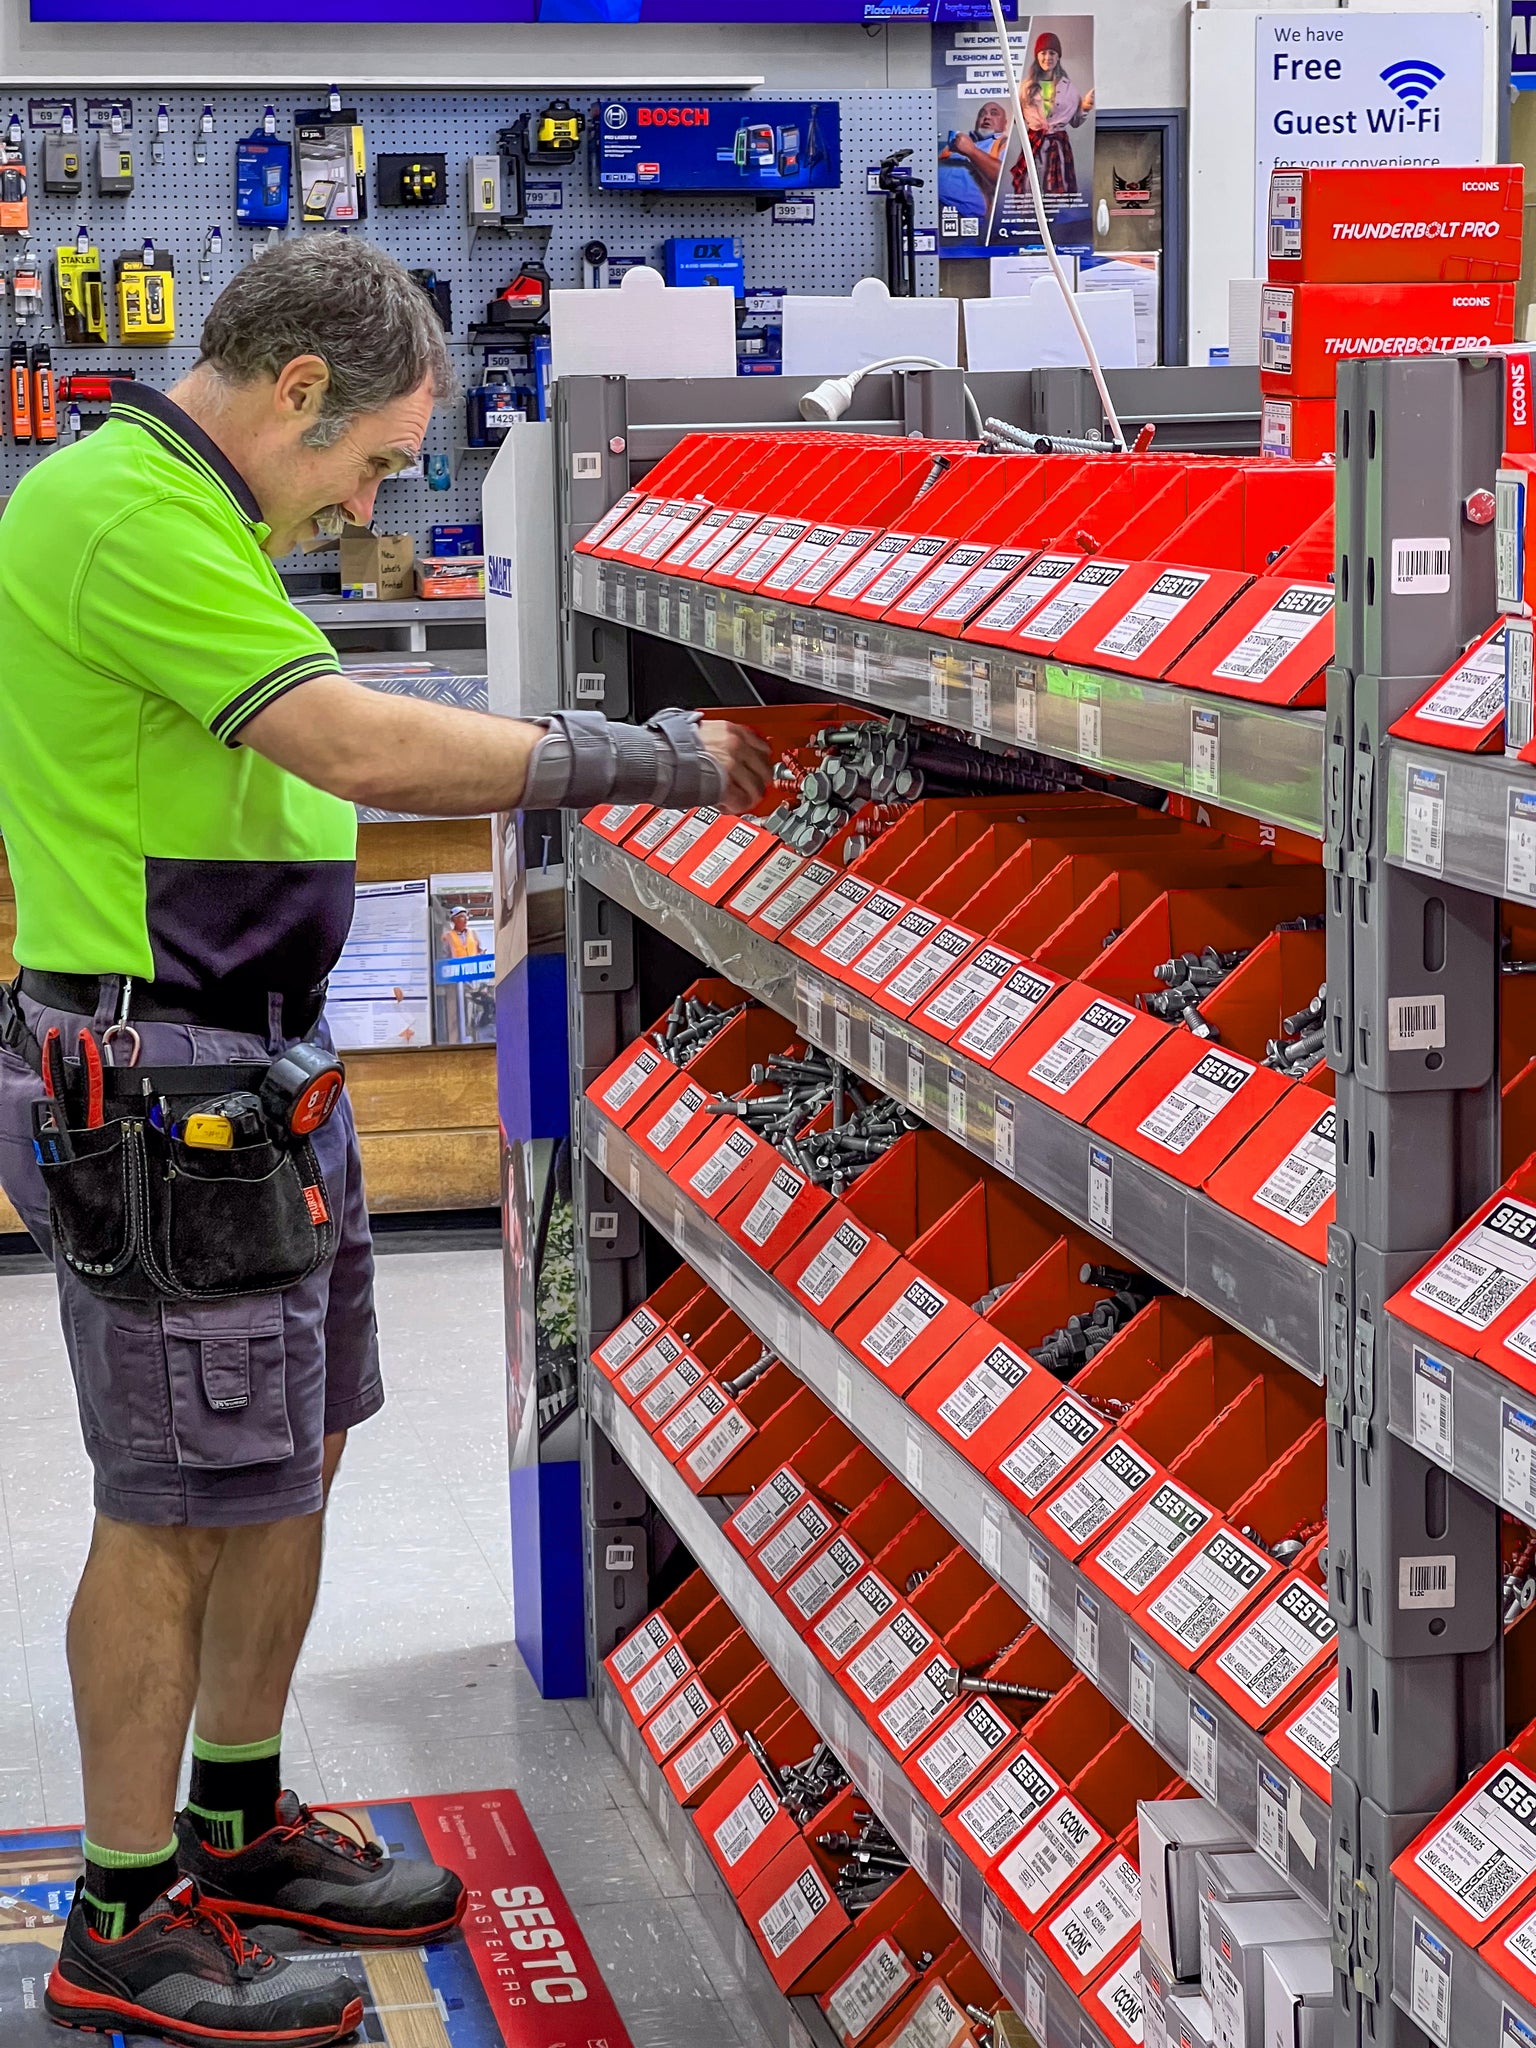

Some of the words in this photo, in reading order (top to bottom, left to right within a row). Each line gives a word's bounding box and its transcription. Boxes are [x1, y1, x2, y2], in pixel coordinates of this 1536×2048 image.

[864, 4, 929, 15] PlaceMakers
[1274, 28, 1301, 42] We
[1306, 27, 1344, 42] have
[1273, 54, 1341, 80] Free
[40, 112, 53, 120] 69
[97, 112, 110, 120] 89
[638, 108, 709, 126] BOSCH
[1273, 110, 1357, 135] Guest
[1366, 107, 1440, 133] Wi-Fi
[1274, 157, 1296, 167] for
[1342, 156, 1440, 167] convenience
[526, 193, 544, 201] 799
[1462, 182, 1499, 191] ICCONS
[779, 206, 796, 215] 399
[944, 222, 955, 230] H1
[1333, 222, 1460, 239] THUNDERBOLT
[1463, 221, 1500, 238] PRO
[61, 256, 96, 264] STANLEY
[693, 244, 724, 259] OX
[753, 299, 765, 308] 97
[1453, 297, 1490, 307] ICCONS
[1325, 337, 1451, 354] THUNDERBOLT
[1453, 336, 1491, 351] PRO
[492, 357, 510, 366] 509
[1512, 364, 1527, 425] ICCONS
[491, 414, 514, 423] 1429
[777, 524, 801, 538] SESTO
[809, 531, 837, 545] SESTO
[841, 532, 869, 544] SESTO
[381, 551, 395, 559] New
[878, 538, 907, 551] SESTO
[911, 539, 943, 553] SESTO
[949, 550, 980, 565] SESTO
[986, 555, 1018, 569] SESTO
[1033, 562, 1069, 577] SESTO
[1078, 567, 1120, 584] SESTO
[381, 580, 403, 590] Printed
[1155, 576, 1199, 597] SESTO
[1279, 592, 1333, 613] SESTO
[697, 807, 718, 824] SESTO
[730, 828, 752, 846] SESTO
[805, 865, 831, 884] SESTO
[838, 880, 867, 900] SESTO
[868, 897, 897, 918] SESTO
[902, 912, 932, 935] SESTO
[935, 930, 967, 955] SESTO
[976, 951, 1010, 975] SESTO
[1010, 976, 1045, 1001] SESTO
[1085, 1006, 1125, 1033] SESTO
[1198, 1058, 1242, 1088] SESTO
[308, 1090, 320, 1109] 8
[682, 1090, 701, 1110] SESTO
[729, 1134, 751, 1155] SESTO
[775, 1169, 799, 1196] SESTO
[1288, 1171, 1322, 1212] ICCONS
[836, 1226, 863, 1254] SESTO
[907, 1285, 942, 1314] SESTO
[1460, 1271, 1498, 1313] ICCONS
[635, 1312, 654, 1333] SESTO
[658, 1338, 678, 1360] SESTO
[678, 1361, 697, 1383] SESTO
[989, 1350, 1024, 1383] SESTO
[700, 1388, 722, 1412] SESTO
[1055, 1406, 1093, 1441] SESTO
[1104, 1448, 1145, 1487] SESTO
[773, 1473, 798, 1502] SESTO
[1155, 1489, 1202, 1531] SESTO
[800, 1507, 825, 1538] SESTO
[831, 1542, 857, 1574] SESTO
[1208, 1538, 1260, 1584] SESTO
[860, 1578, 890, 1612] SESTO
[1177, 1597, 1212, 1635] ICCONS
[1285, 1590, 1336, 1637] SESTO
[647, 1619, 665, 1645] SESTO
[893, 1616, 926, 1652] SESTO
[666, 1647, 684, 1675] SESTO
[1248, 1649, 1284, 1688] ICCONS
[684, 1684, 706, 1715] SESTO
[968, 1704, 1003, 1745] SESTO
[1294, 1723, 1308, 1739] SKU:
[712, 1721, 731, 1751] SESTO
[1013, 1758, 1048, 1800] SESTO
[751, 1786, 773, 1821] SESTO
[1058, 1808, 1088, 1844] ICCONS
[1453, 1820, 1485, 1852] NNR05025
[1424, 1850, 1441, 1869] SKU:
[1461, 1852, 1500, 1896] ICCONS
[800, 1873, 824, 1909] SESTO
[467, 1890, 526, 2007] FASTENERS
[491, 1886, 588, 2004] SESTO
[1062, 1919, 1092, 1956] ICCONS
[1516, 1933, 1533, 1952] SKU:
[1111, 1984, 1145, 2024] ICCONS
